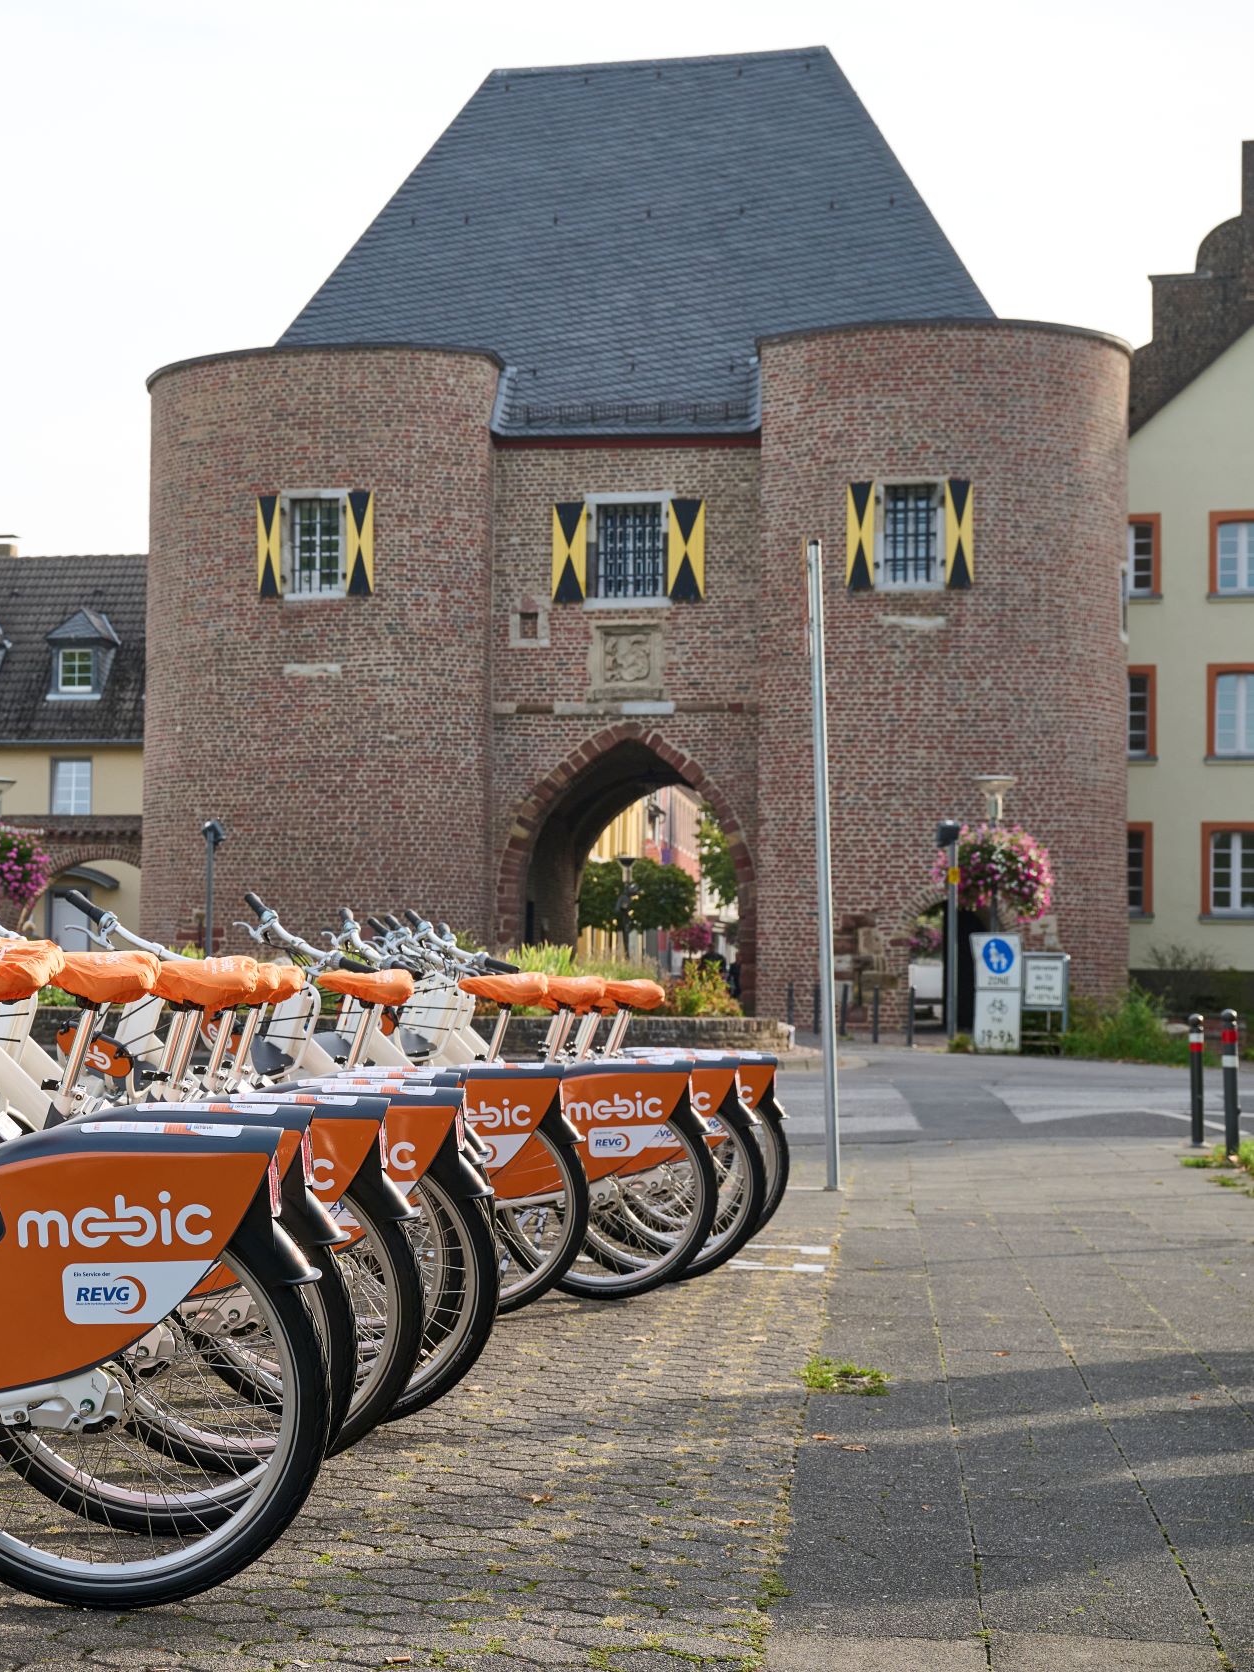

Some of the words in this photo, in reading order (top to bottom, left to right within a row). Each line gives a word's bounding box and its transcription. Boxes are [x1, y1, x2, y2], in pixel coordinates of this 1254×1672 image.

[987, 976, 1010, 986] ZONE
[595, 1138, 622, 1147] REVG
[76, 1286, 130, 1302] REVG
